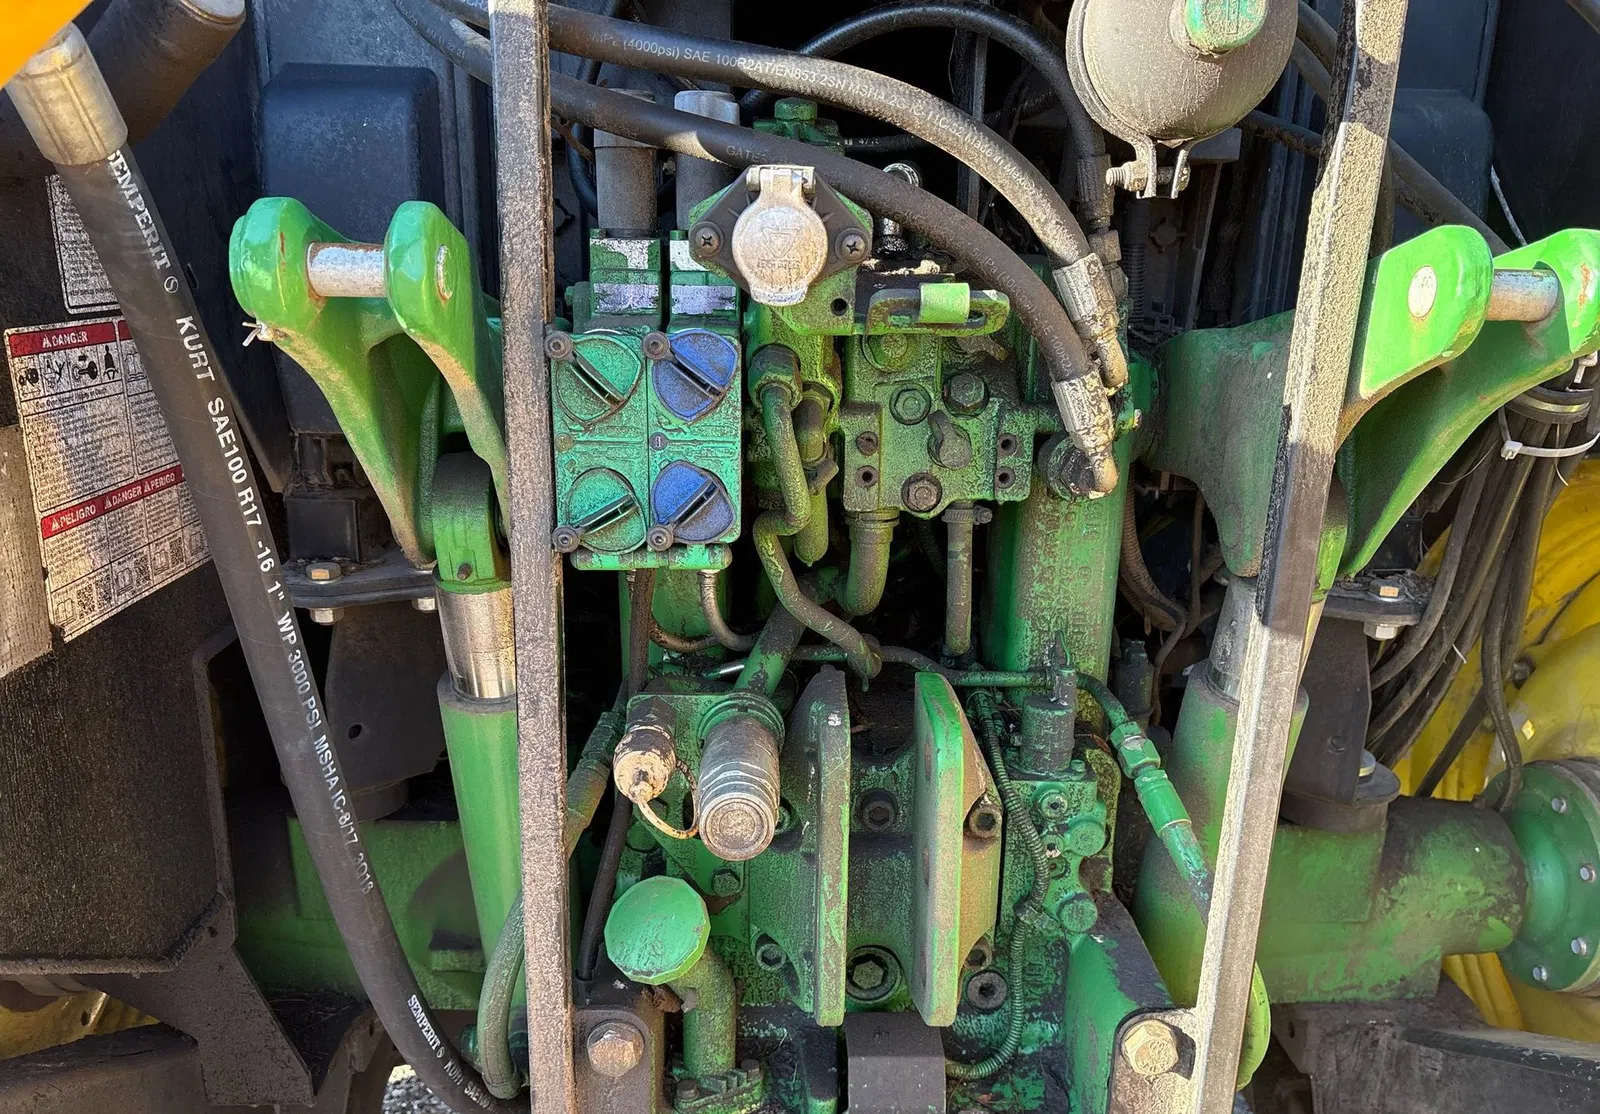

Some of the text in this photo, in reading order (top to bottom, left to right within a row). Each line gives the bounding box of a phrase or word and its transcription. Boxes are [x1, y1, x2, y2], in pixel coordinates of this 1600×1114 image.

[623, 38, 680, 60] (4000psi)
[683, 48, 711, 63] SAE
[819, 74, 846, 90] 2SN
[849, 81, 885, 102] MSHA
[964, 131, 992, 157] Made
[993, 153, 1004, 166] in
[726, 145, 768, 164] GATES
[51, 331, 89, 347] DANGER
[60, 472, 176, 528] PELIGRO DANGER PERIGO
[176, 315, 215, 382] KURT
[207, 396, 248, 484] SAE100
[237, 486, 262, 526] R17
[256, 540, 275, 573] -16
[267, 580, 285, 600] 1"
[276, 611, 297, 645] WP
[288, 649, 311, 695] 3000
[302, 695, 322, 731] PSI
[313, 734, 339, 791] MSHA
[331, 789, 358, 846] IC-8/17
[407, 994, 441, 1051] SEMPERIT
